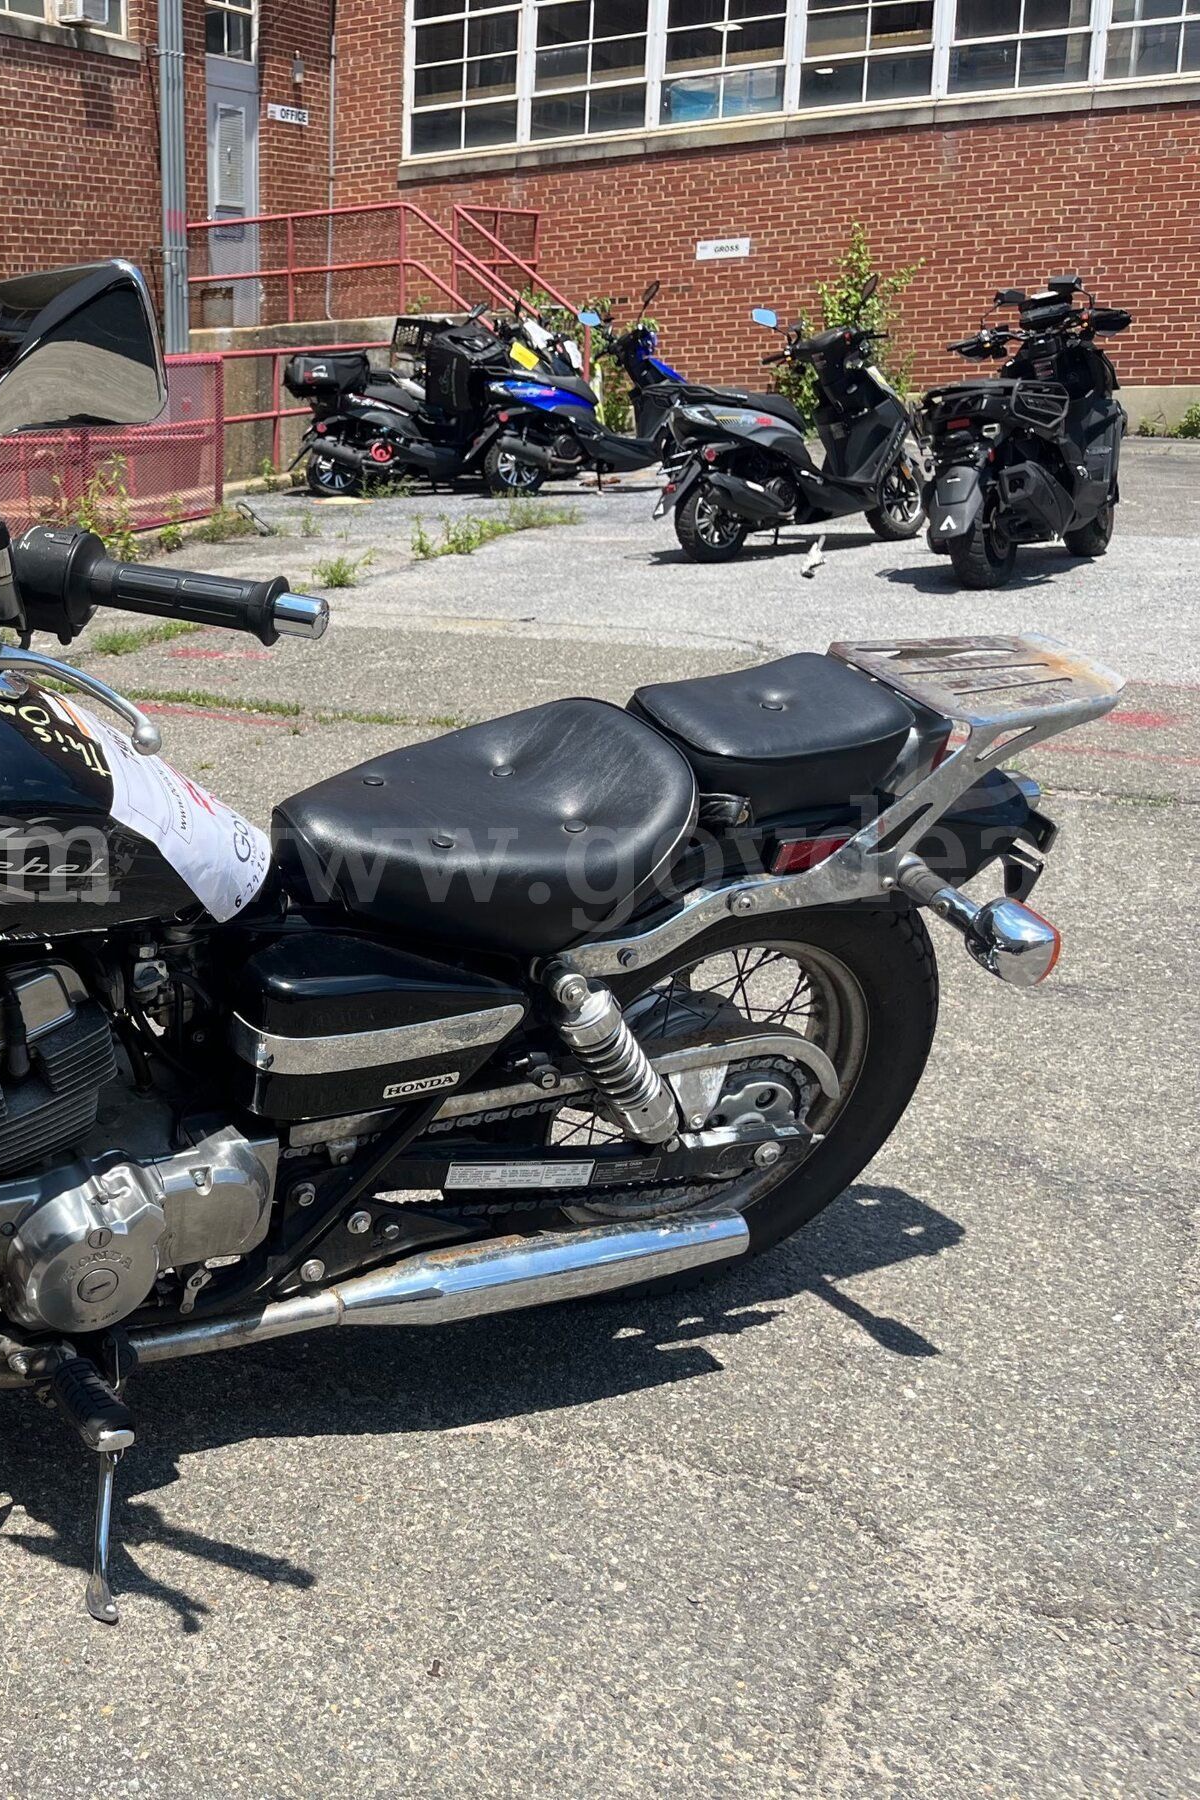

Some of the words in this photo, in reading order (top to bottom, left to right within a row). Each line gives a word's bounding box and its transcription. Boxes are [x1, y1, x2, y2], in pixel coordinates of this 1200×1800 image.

[280, 107, 306, 123] OFFICE
[714, 244, 740, 253] GROSS
[386, 1075, 456, 1096] HONDA
